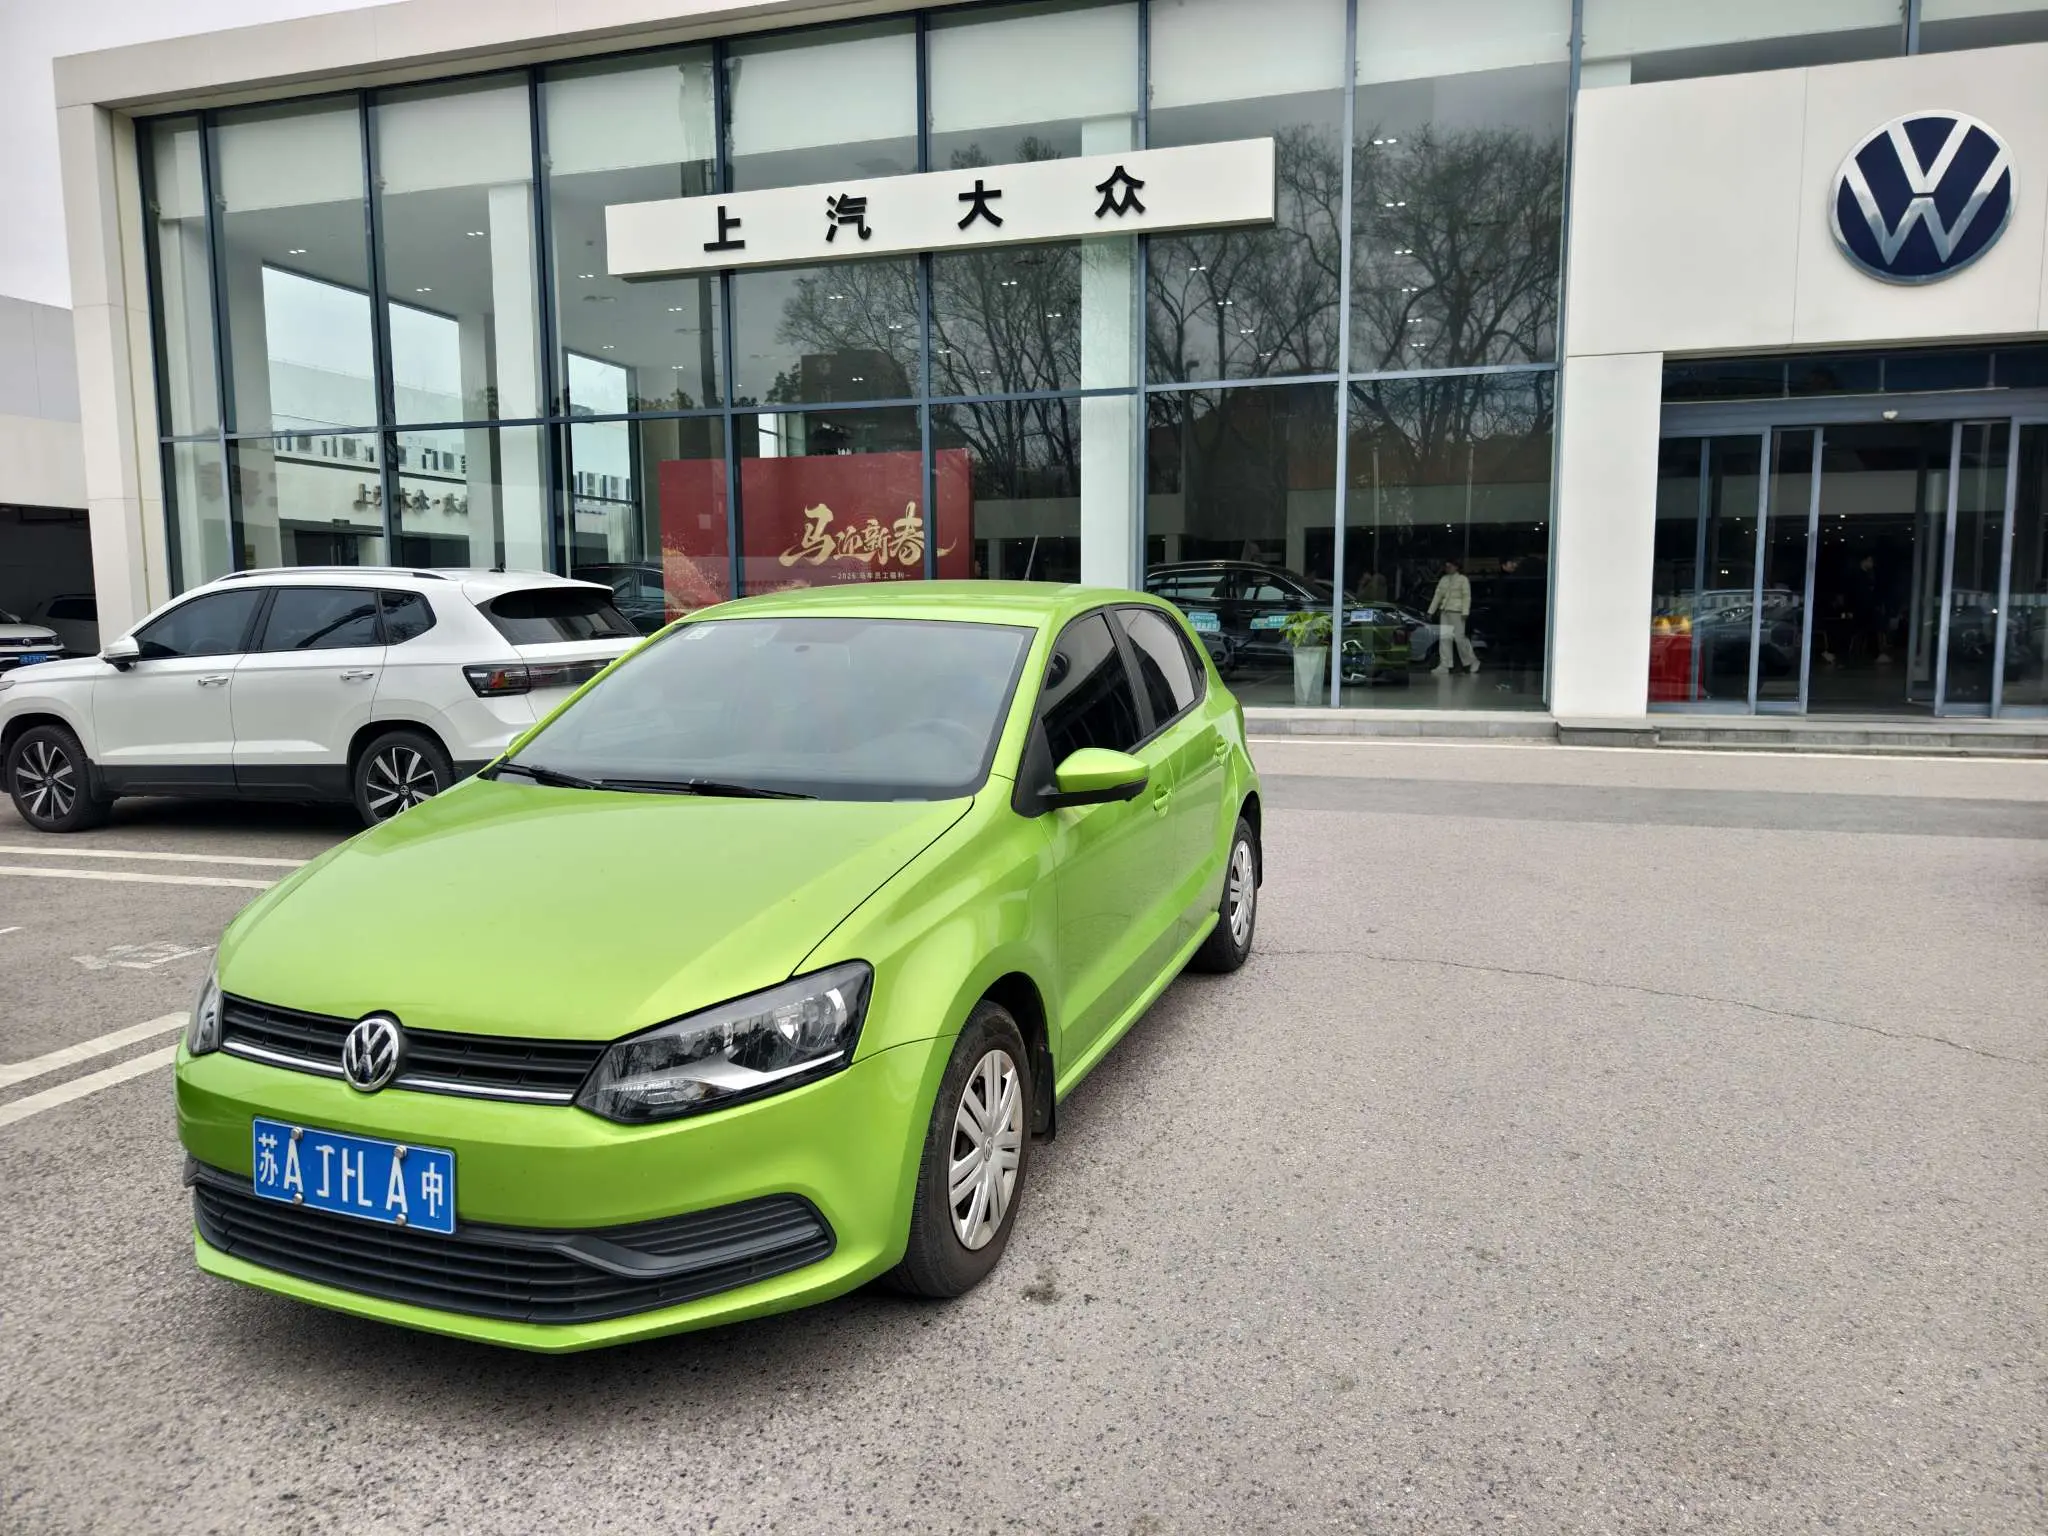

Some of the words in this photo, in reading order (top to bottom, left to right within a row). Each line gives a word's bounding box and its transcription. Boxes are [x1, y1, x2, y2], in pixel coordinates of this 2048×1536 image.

[703, 165, 1146, 253] 上汽大众
[779, 501, 957, 567] 马迎新春
